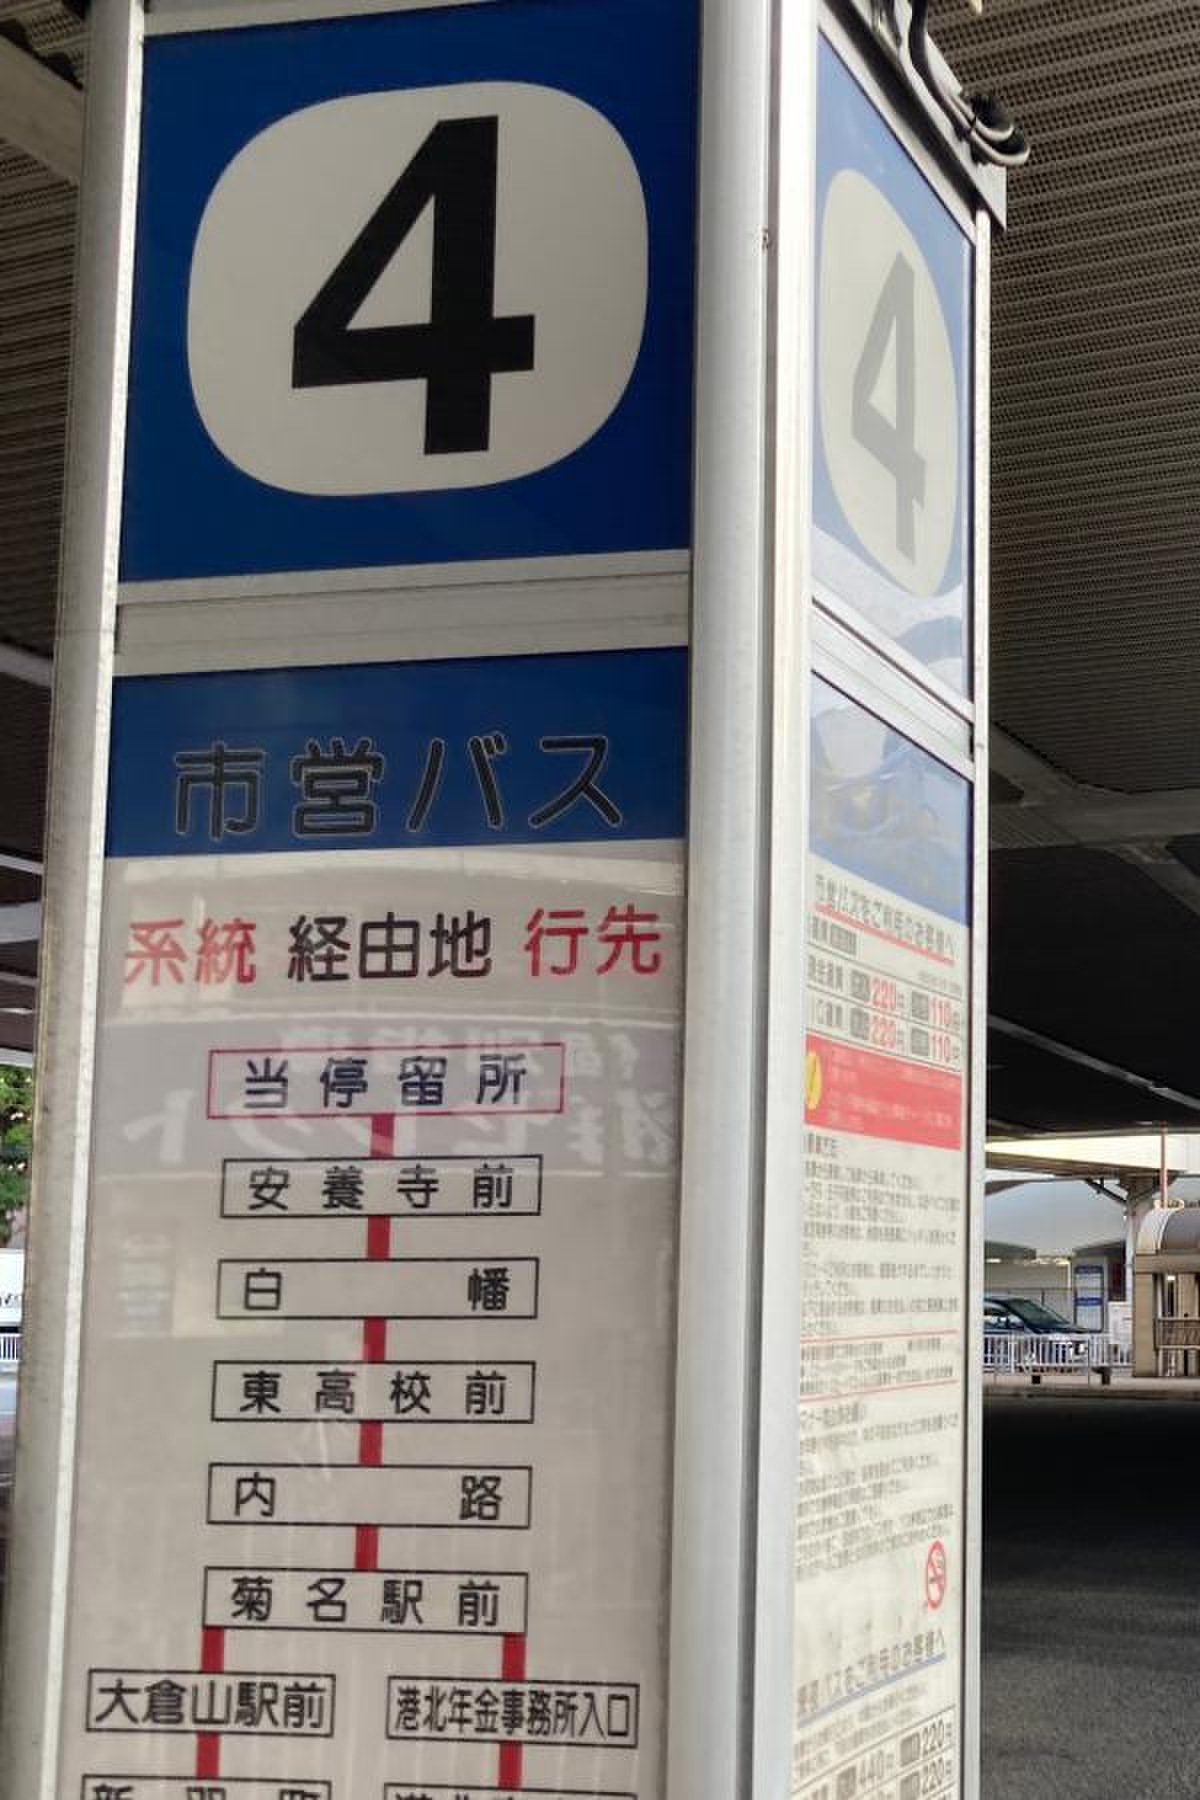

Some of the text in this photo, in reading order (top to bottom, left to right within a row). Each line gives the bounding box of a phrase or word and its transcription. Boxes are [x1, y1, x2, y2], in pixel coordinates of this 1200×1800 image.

[292, 114, 535, 455] 4
[851, 251, 926, 564] 4
[174, 732, 623, 840] 市営バス
[125, 904, 662, 986] 系統 経由地 行先
[243, 1053, 527, 1109] 当停留所
[247, 1164, 512, 1213] 安養寺前
[243, 1266, 511, 1312] 白幡
[239, 1369, 507, 1415] 東高校前
[234, 1472, 502, 1523] 内路
[231, 1576, 499, 1627] 菊名駅前
[95, 1679, 325, 1729] 大倉山駅前
[395, 1683, 630, 1738] 港北年金事務所入口
